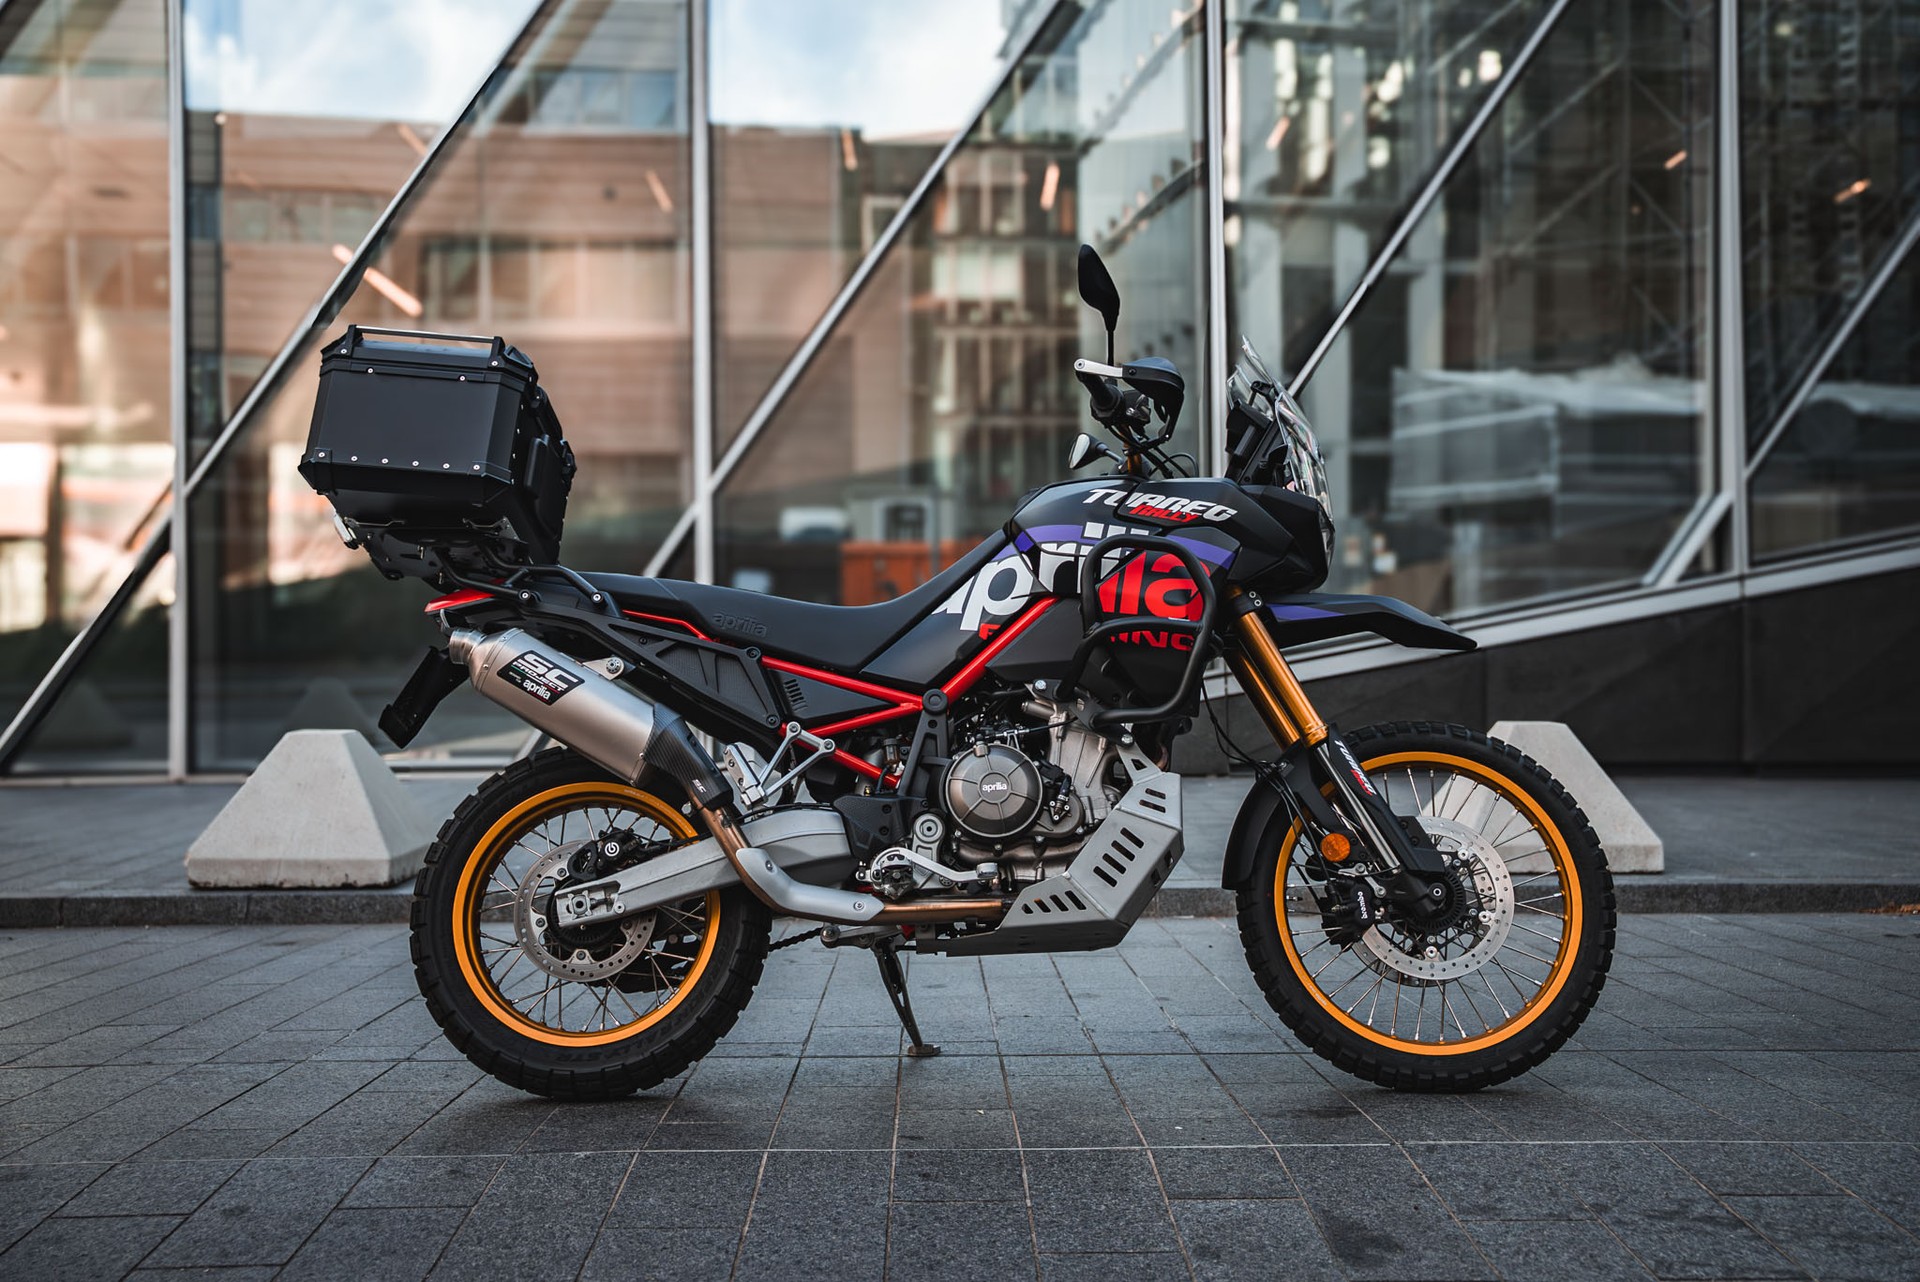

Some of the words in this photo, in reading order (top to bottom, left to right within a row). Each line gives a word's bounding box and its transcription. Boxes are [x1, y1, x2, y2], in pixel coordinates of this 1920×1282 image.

[1082, 488, 1238, 522] TUAREG
[1129, 505, 1199, 523] RALLY
[713, 611, 768, 638] aprilia
[512, 661, 565, 692] PROJECT
[517, 653, 579, 689] SC
[523, 679, 551, 700] aprilia
[982, 781, 1008, 793] aprilia
[1357, 891, 1368, 919] brembo
